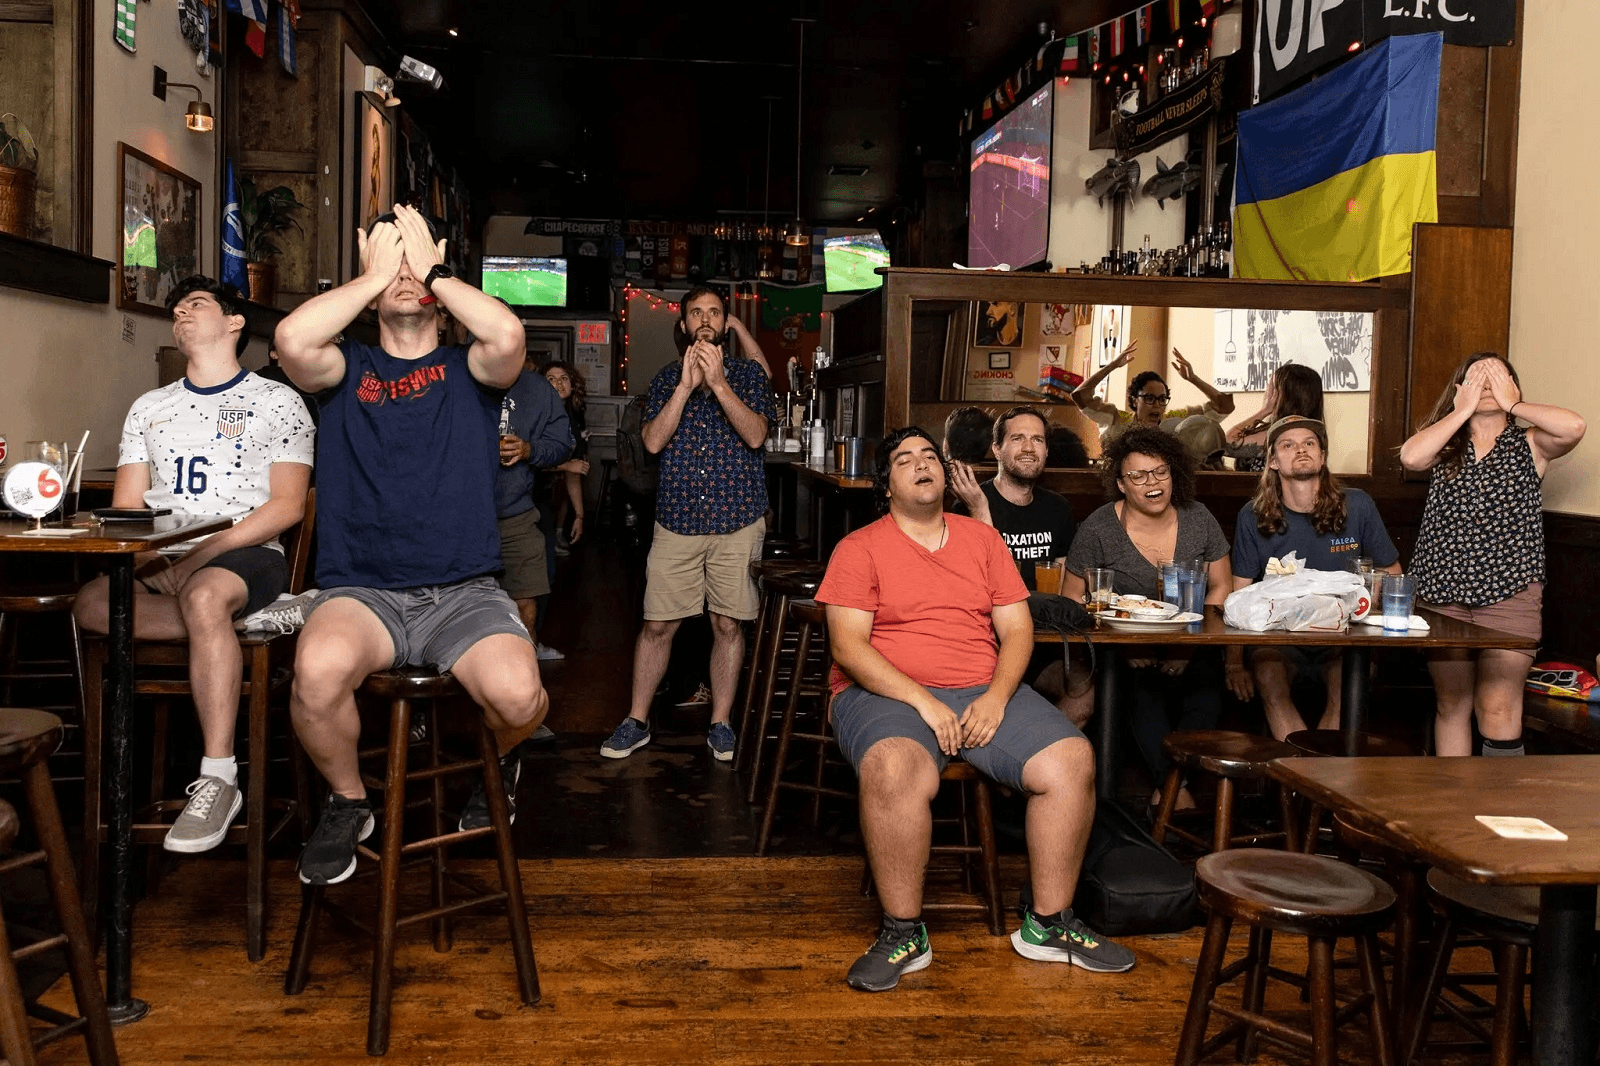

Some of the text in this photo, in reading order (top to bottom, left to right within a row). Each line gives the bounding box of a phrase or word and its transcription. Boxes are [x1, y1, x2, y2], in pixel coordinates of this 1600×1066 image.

[1135, 86, 1208, 136] FOOTBALL NEVER SLEEPS
[544, 221, 606, 234] CHAPECOENSE
[579, 323, 607, 343] EXIT
[221, 411, 244, 424] USA
[38, 468, 61, 498] 6
[173, 456, 209, 494] 16
[1014, 545, 1051, 560] THEFT
[1330, 544, 1350, 553] BEER
